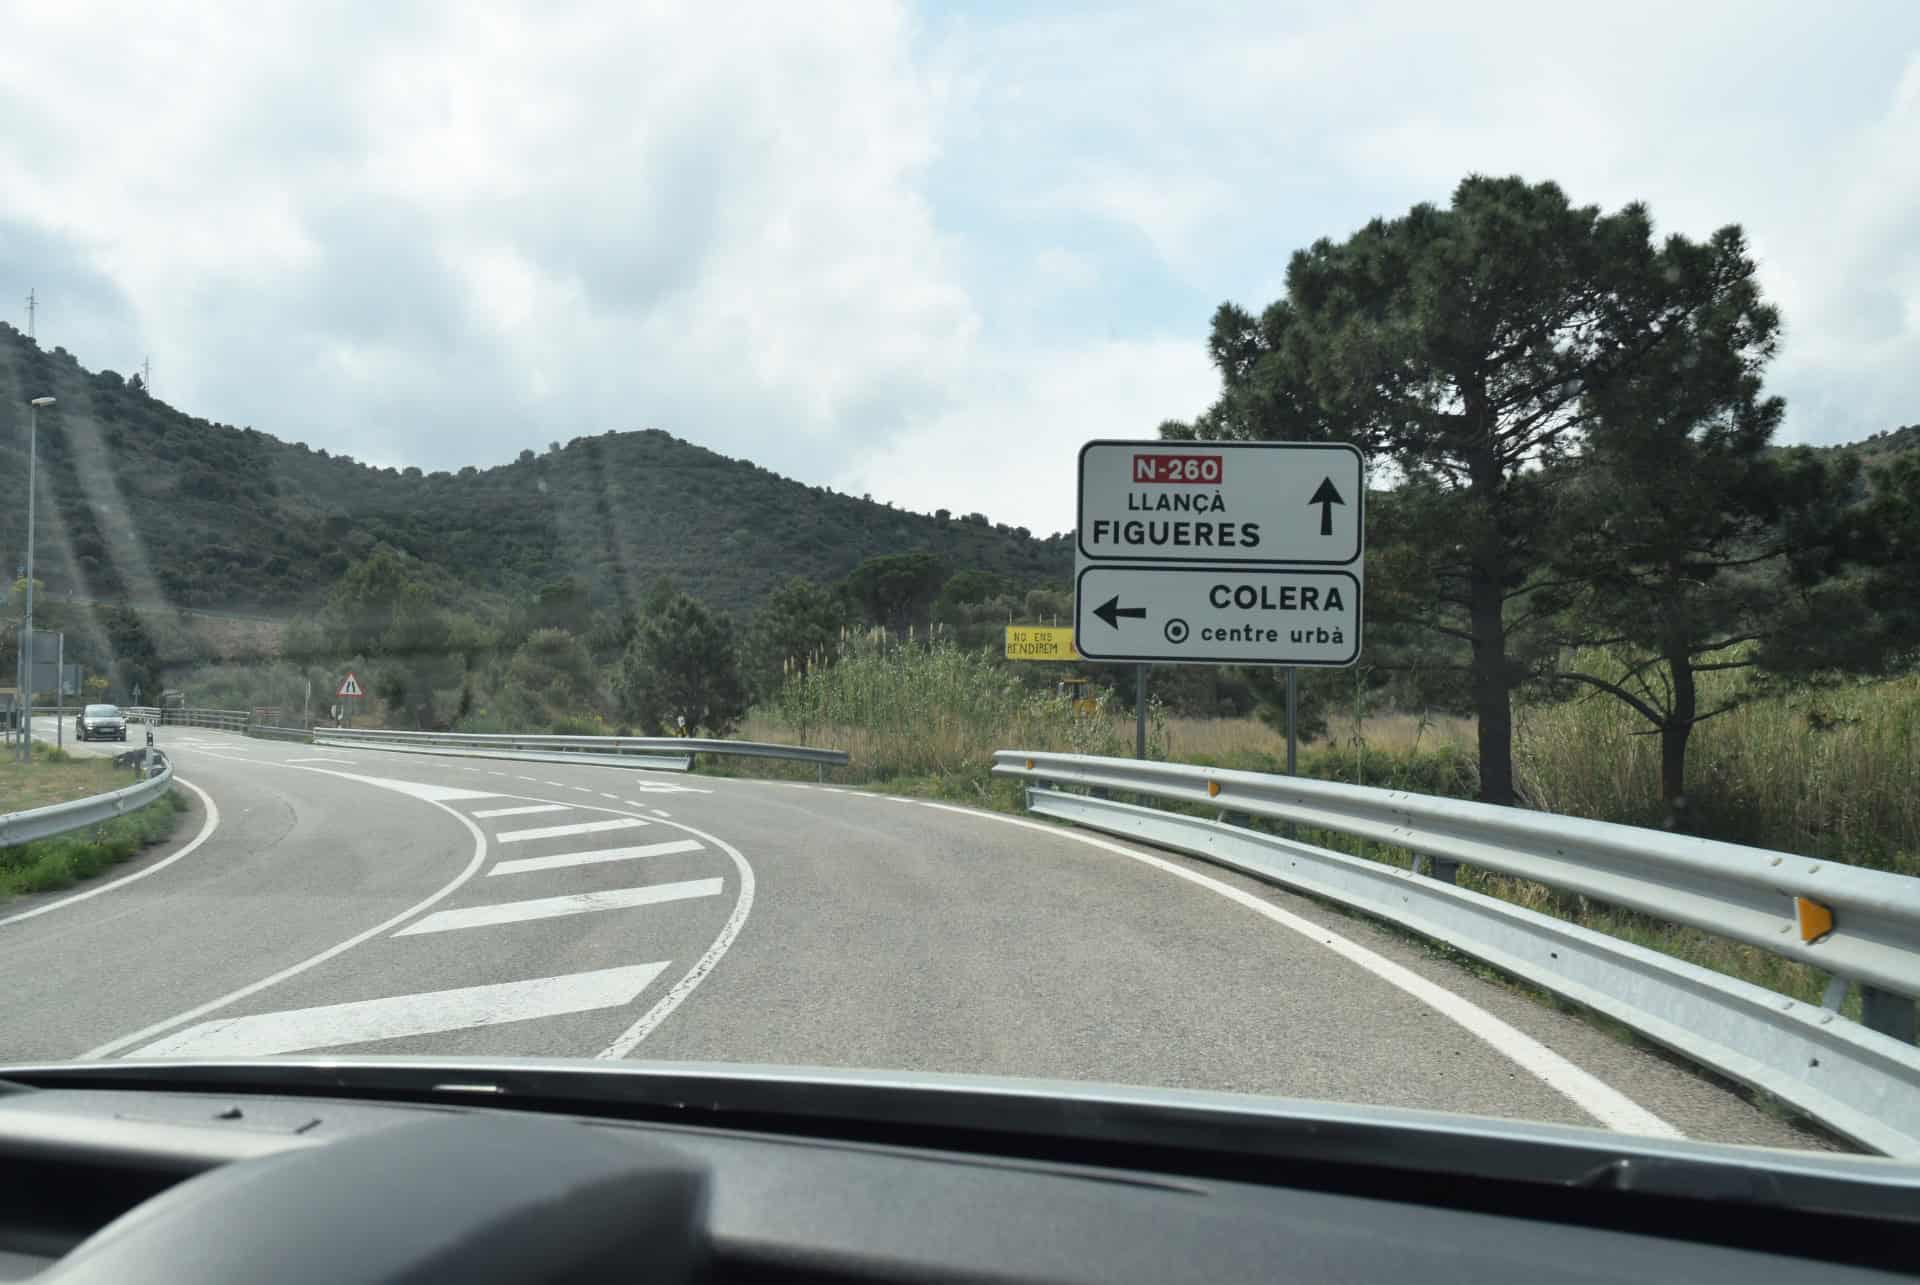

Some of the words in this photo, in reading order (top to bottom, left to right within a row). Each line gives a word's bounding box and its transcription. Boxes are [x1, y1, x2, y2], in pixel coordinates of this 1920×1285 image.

[1136, 459, 1219, 480] N-260
[1128, 490, 1226, 514] LLANÇÀ
[1093, 520, 1261, 547] FIGUERES
[1209, 585, 1345, 611] COLERA
[1013, 632, 1027, 642] NO
[1201, 624, 1278, 643] centre
[1290, 626, 1344, 644] urbà
